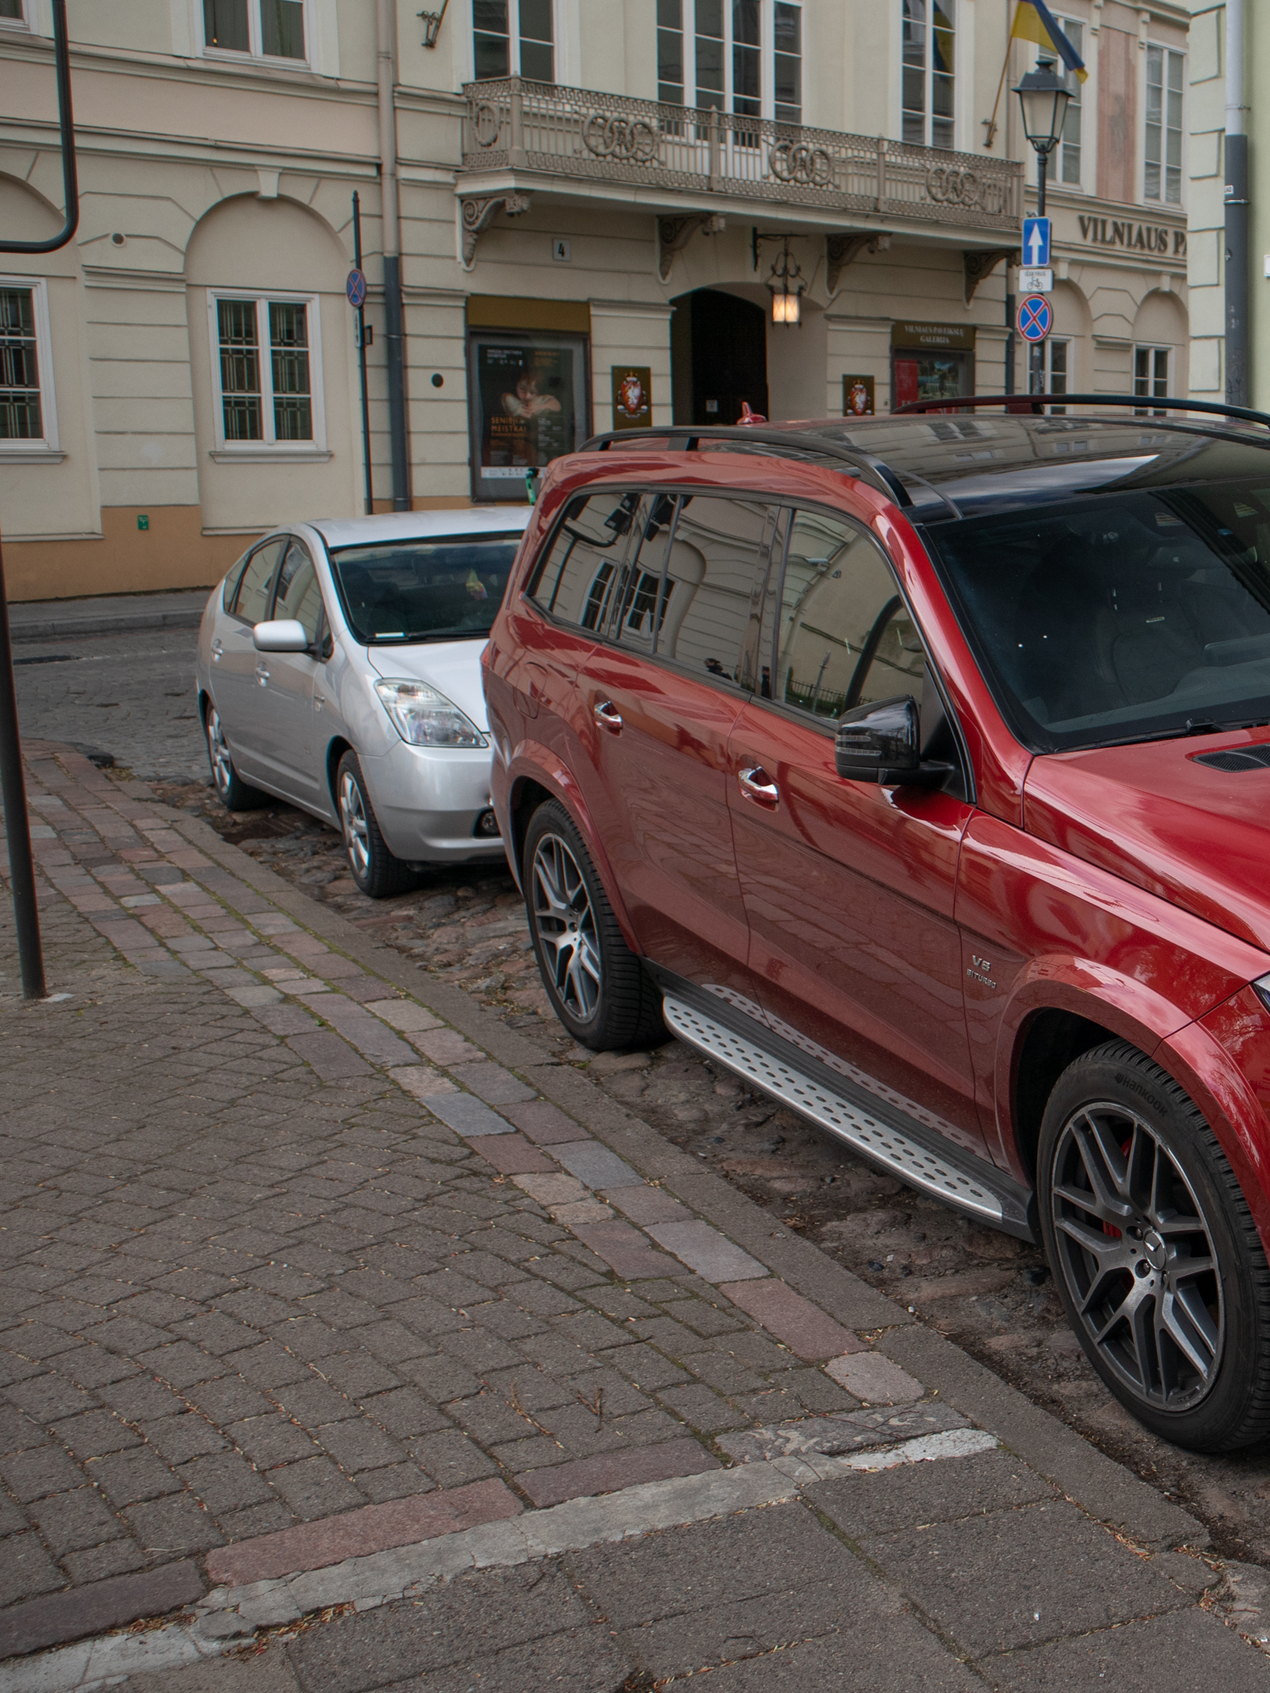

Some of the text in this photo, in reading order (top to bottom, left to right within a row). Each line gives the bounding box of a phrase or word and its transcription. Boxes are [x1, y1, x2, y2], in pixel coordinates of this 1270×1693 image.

[1078, 214, 1169, 253] VILNIAUS
[557, 242, 566, 258] 4
[971, 954, 991, 972] V8
[966, 968, 997, 989] BITURBO
